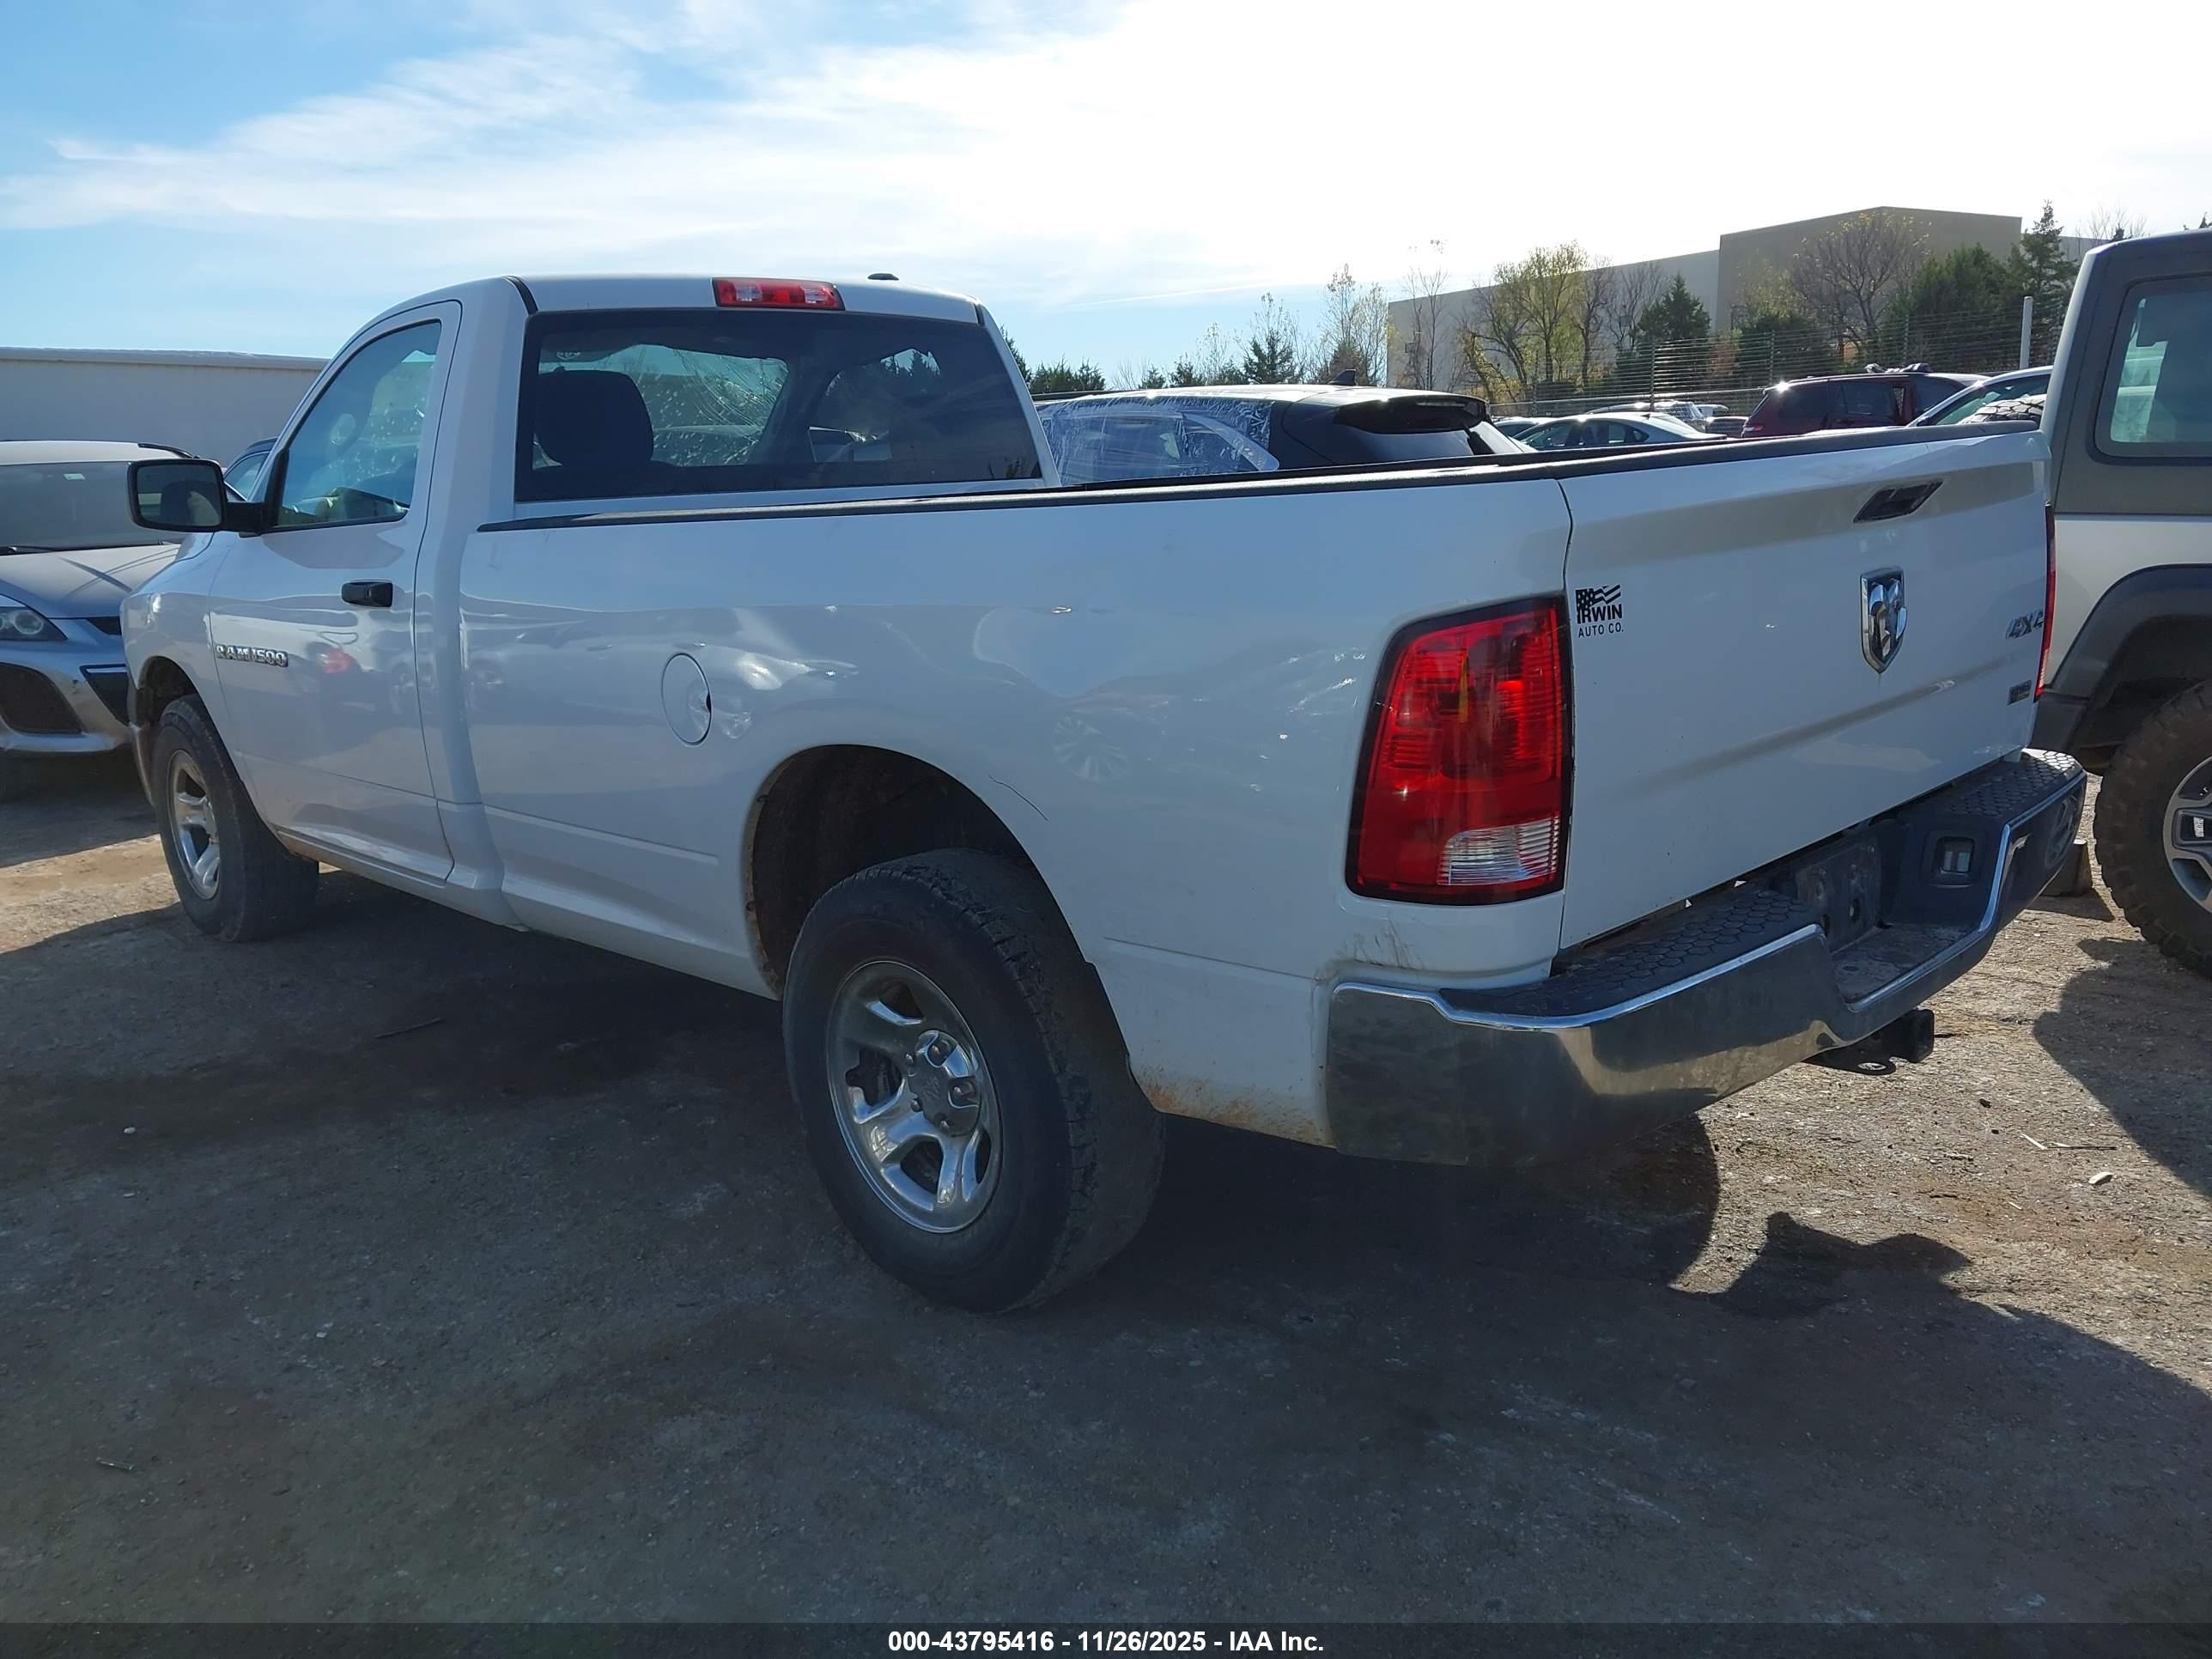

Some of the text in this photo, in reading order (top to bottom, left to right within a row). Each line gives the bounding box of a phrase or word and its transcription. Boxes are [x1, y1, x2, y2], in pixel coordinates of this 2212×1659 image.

[1577, 604, 1623, 624] IRWIN
[1577, 622, 1625, 638] AUTO CO.
[215, 644, 289, 667] RAM 1500
